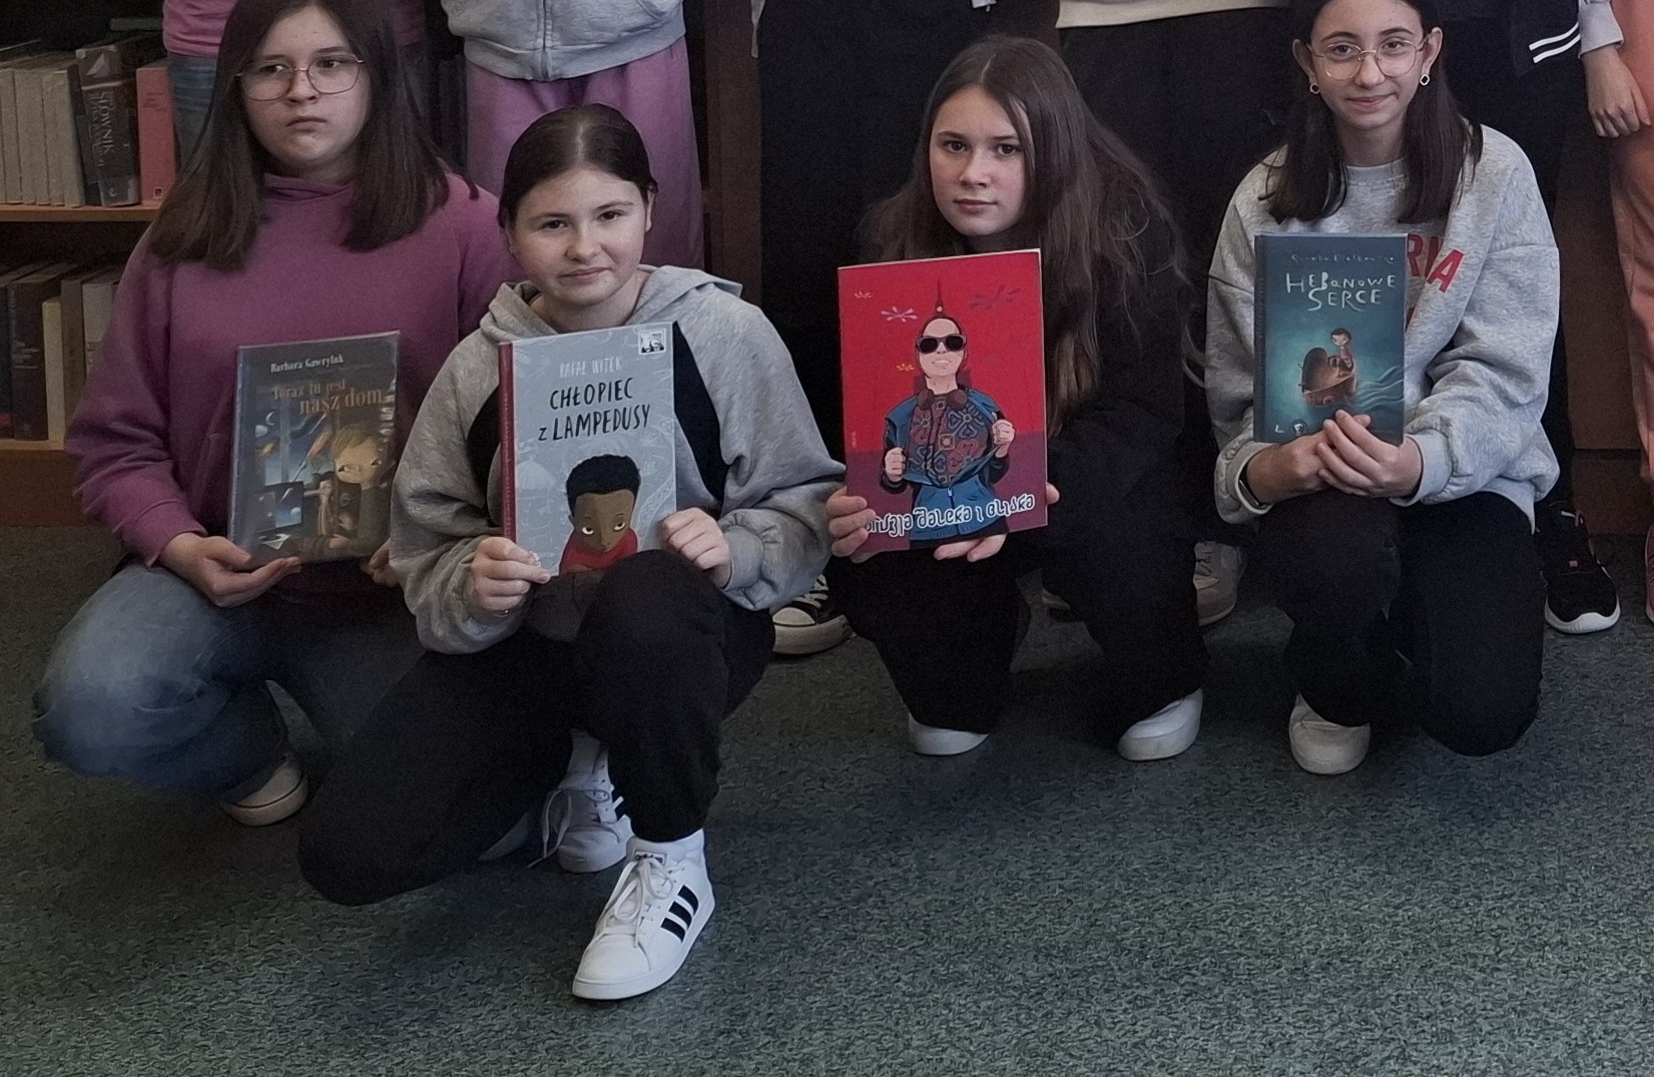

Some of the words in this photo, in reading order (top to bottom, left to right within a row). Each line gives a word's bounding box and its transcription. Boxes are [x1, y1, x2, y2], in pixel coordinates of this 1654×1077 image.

[1307, 289, 1382, 312] SERCE
[272, 385, 305, 400] Teraz
[309, 383, 323, 395] tu
[326, 379, 346, 397] jest
[300, 394, 342, 415] nasz
[344, 387, 383, 408] dom
[550, 377, 634, 411] CHŁOPIEC
[552, 404, 651, 441] LAMPEDUSY
